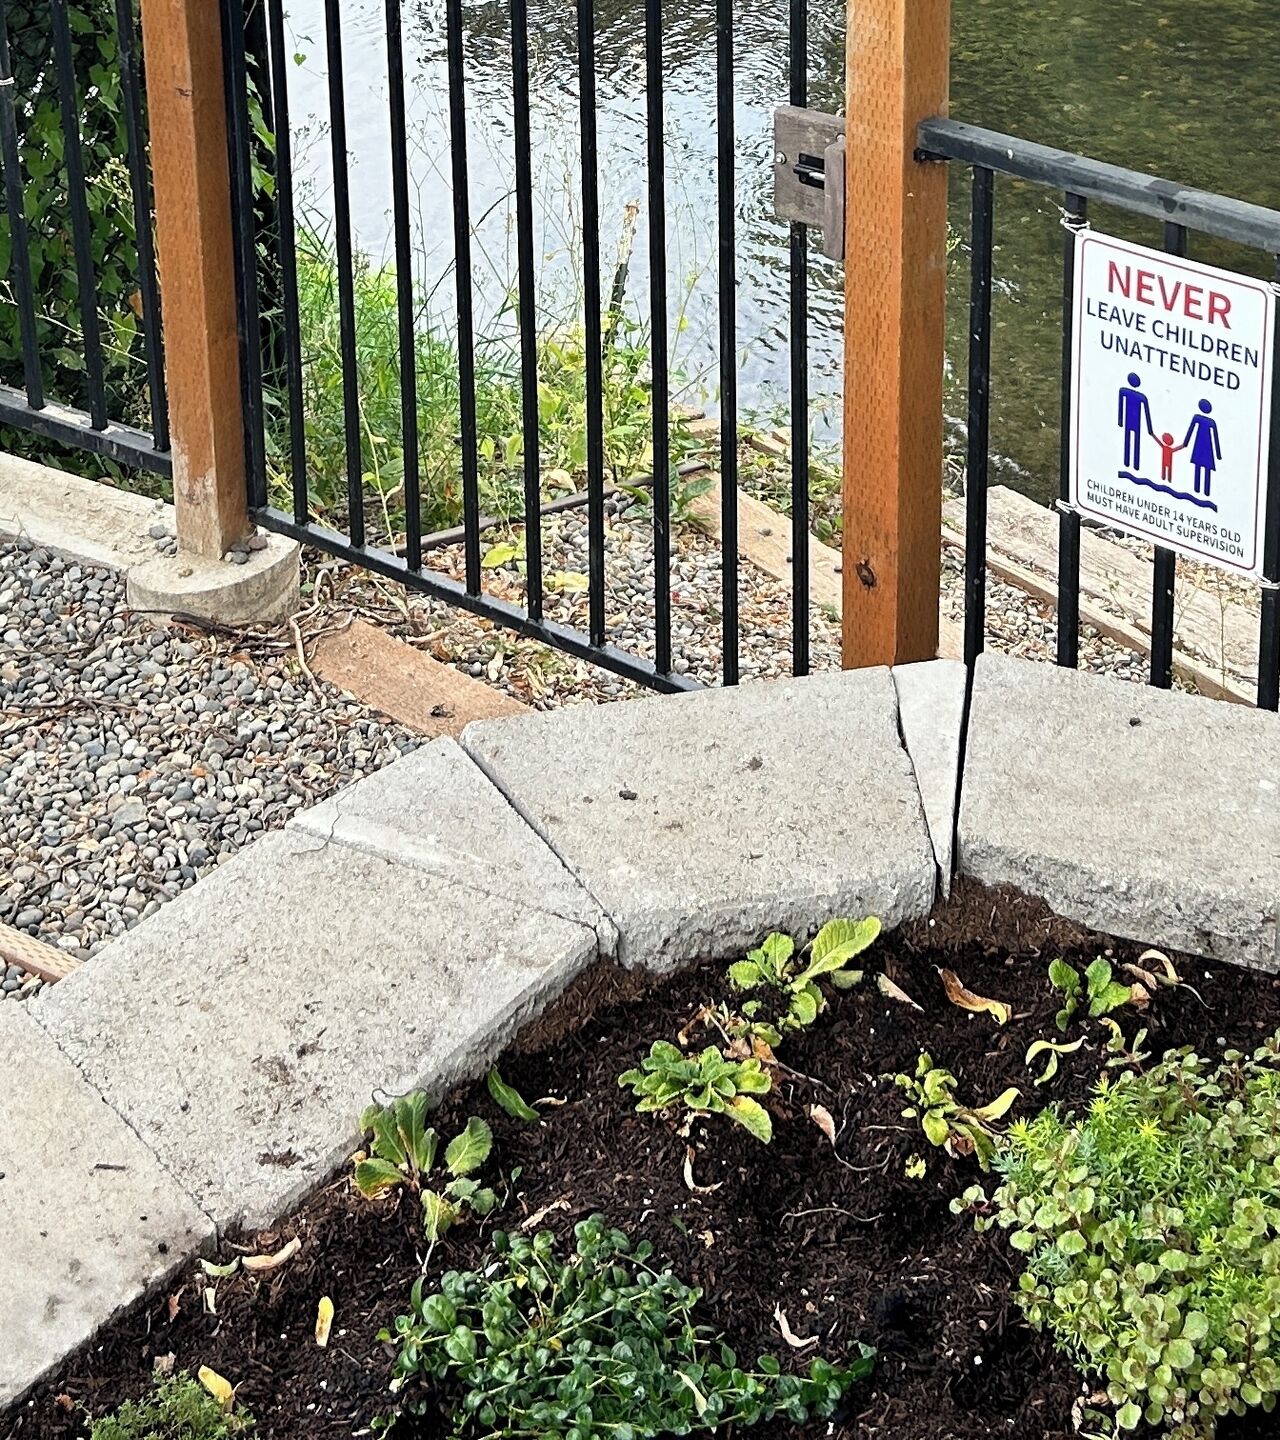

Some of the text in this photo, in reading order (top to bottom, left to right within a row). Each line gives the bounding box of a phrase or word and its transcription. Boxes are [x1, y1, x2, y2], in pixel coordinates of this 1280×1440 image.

[1108, 261, 1232, 330] NEVER
[1087, 298, 1259, 369] LEAVE CHILDREN
[1100, 330, 1240, 391] UNATTENDED
[1087, 479, 1241, 544] CHILDREN UNDER 14 YEARS OLD
[1087, 491, 1244, 558] MUST HAVE ADULT SUPERVISION
